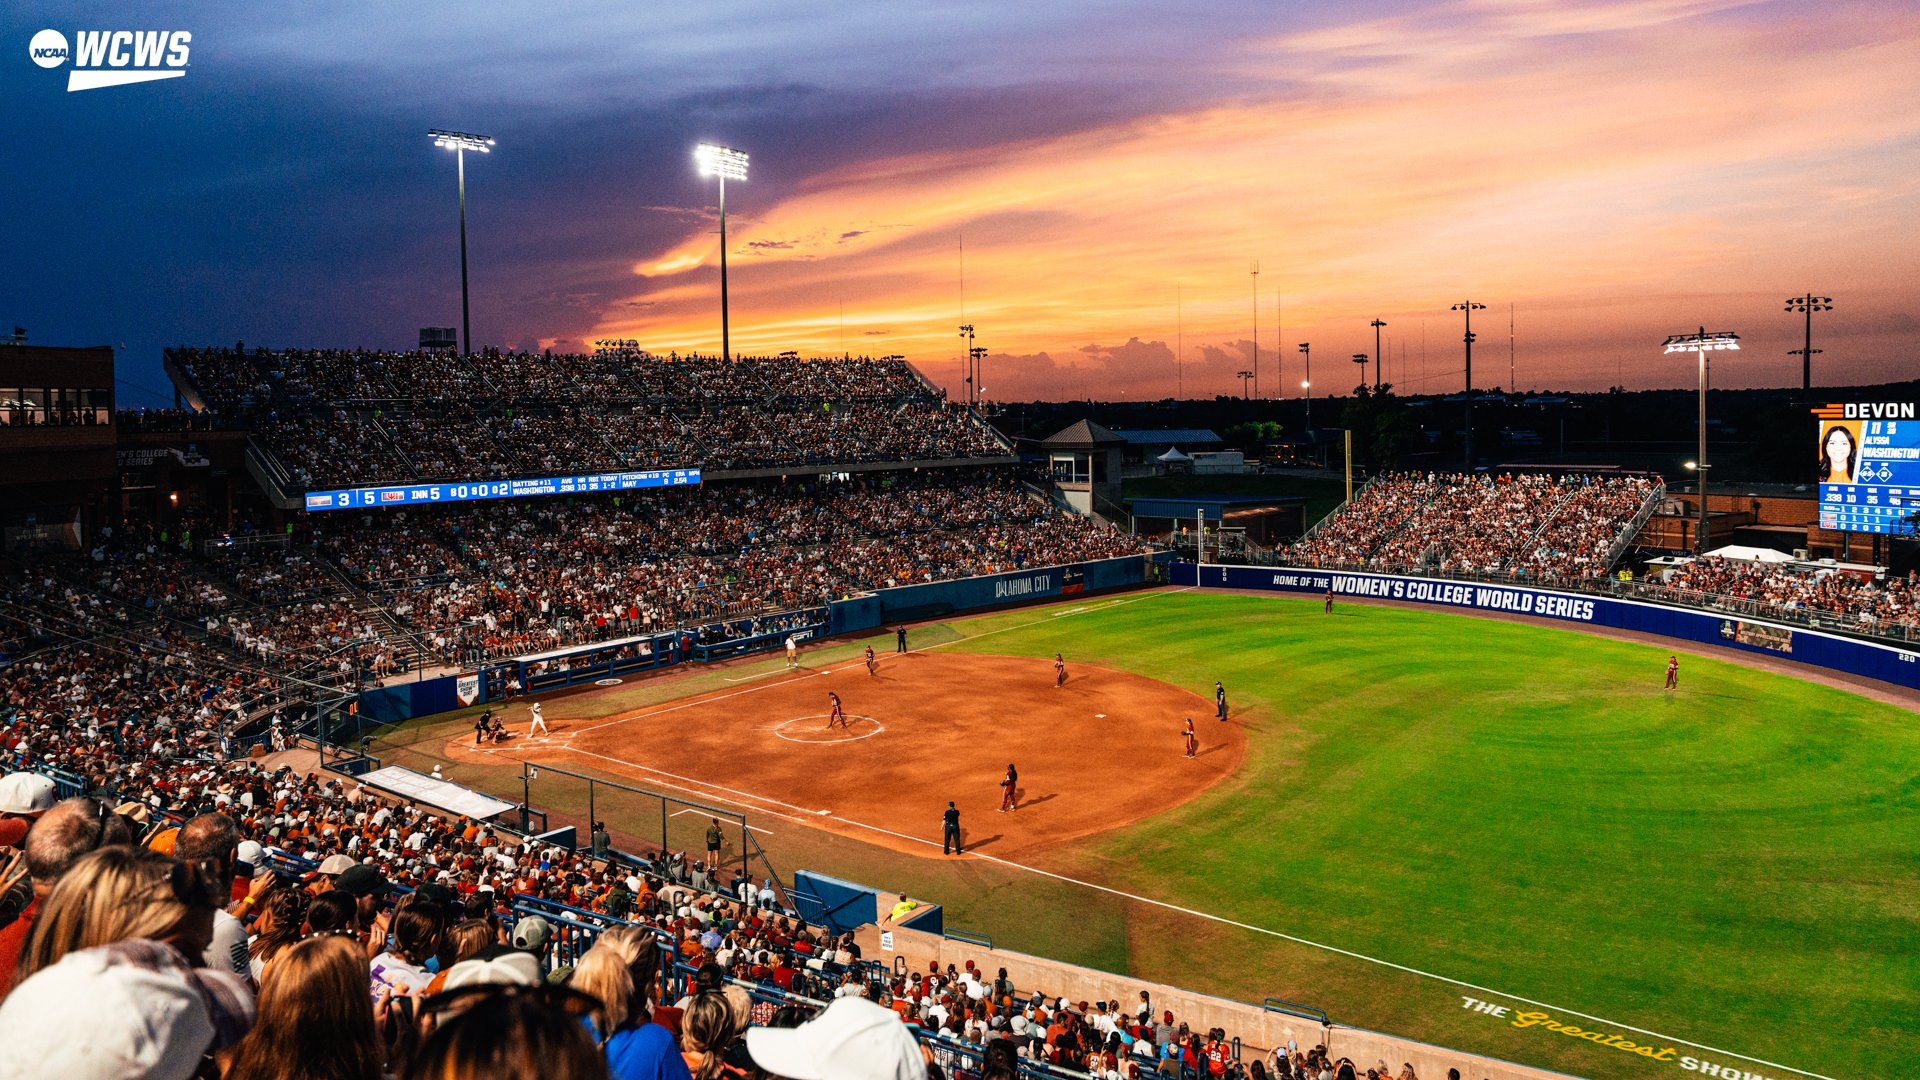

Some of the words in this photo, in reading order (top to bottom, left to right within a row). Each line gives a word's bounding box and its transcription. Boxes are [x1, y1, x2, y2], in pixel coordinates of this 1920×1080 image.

[1845, 402, 1914, 418] DEVON
[1863, 447, 1920, 459] WASHINGTON
[622, 473, 648, 481] PITCHING
[512, 485, 556, 496] WASHINGTON
[577, 483, 587, 491] 10
[622, 480, 637, 488] MAY
[338, 493, 350, 507] 3
[364, 491, 375, 505] 5
[411, 490, 428, 500] INN
[430, 487, 440, 500] 5
[1846, 494, 1856, 503] 10
[995, 577, 1033, 599] OKLAHOMA
[1034, 574, 1051, 593] CITY
[1273, 575, 1298, 586] HOME
[1299, 576, 1311, 587] OF
[1313, 577, 1329, 588] THE
[1331, 575, 1404, 598] WOMEN'S
[1406, 582, 1474, 605] COLLEGE
[1475, 587, 1533, 612] WORLD
[1534, 595, 1594, 620] SERIES
[1898, 653, 1916, 663] 220
[1461, 996, 1511, 1019] THE
[1510, 1009, 1677, 1062] Greatest
